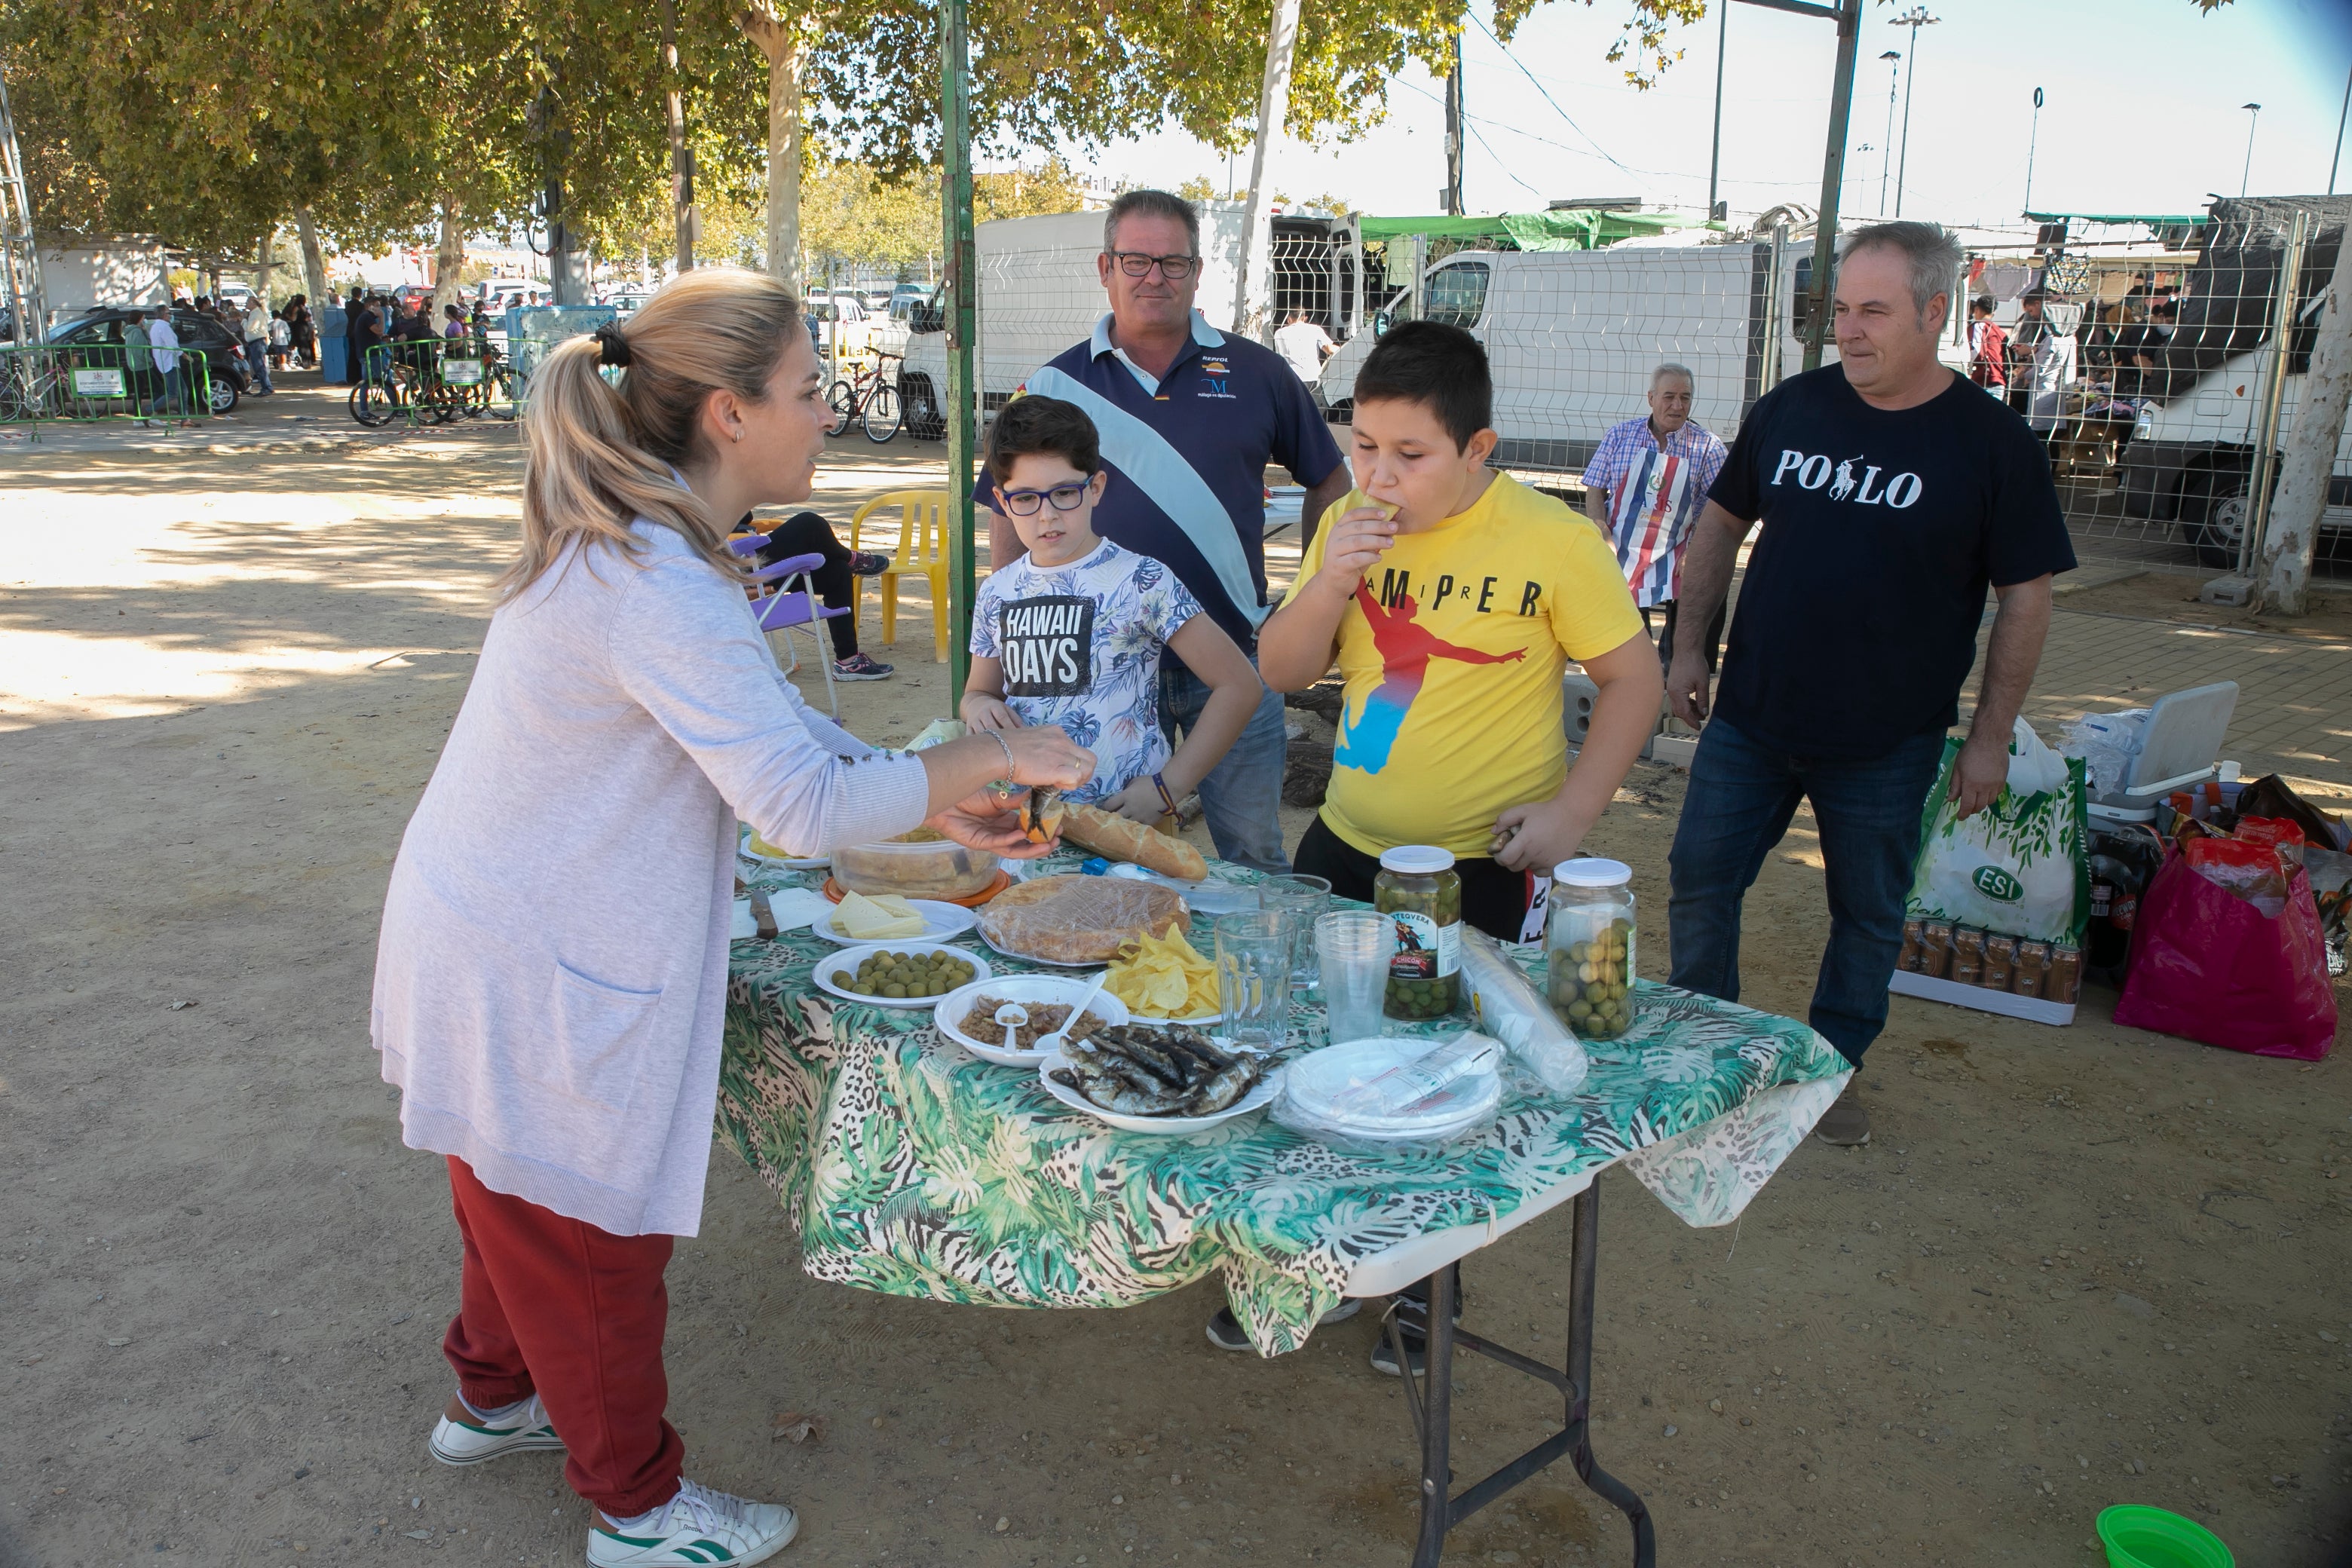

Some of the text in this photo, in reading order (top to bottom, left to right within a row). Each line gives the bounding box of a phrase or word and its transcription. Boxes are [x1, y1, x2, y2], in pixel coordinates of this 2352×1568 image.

[1771, 449, 1922, 509] POLO
[1349, 568, 1542, 617] MPER
[1006, 605, 1084, 638] HAWAII
[1006, 638, 1078, 684] DAYS
[1978, 868, 2015, 899] ESI
[1390, 913, 1429, 926] NTEQVERA
[683, 1524, 704, 1533] Reebo
